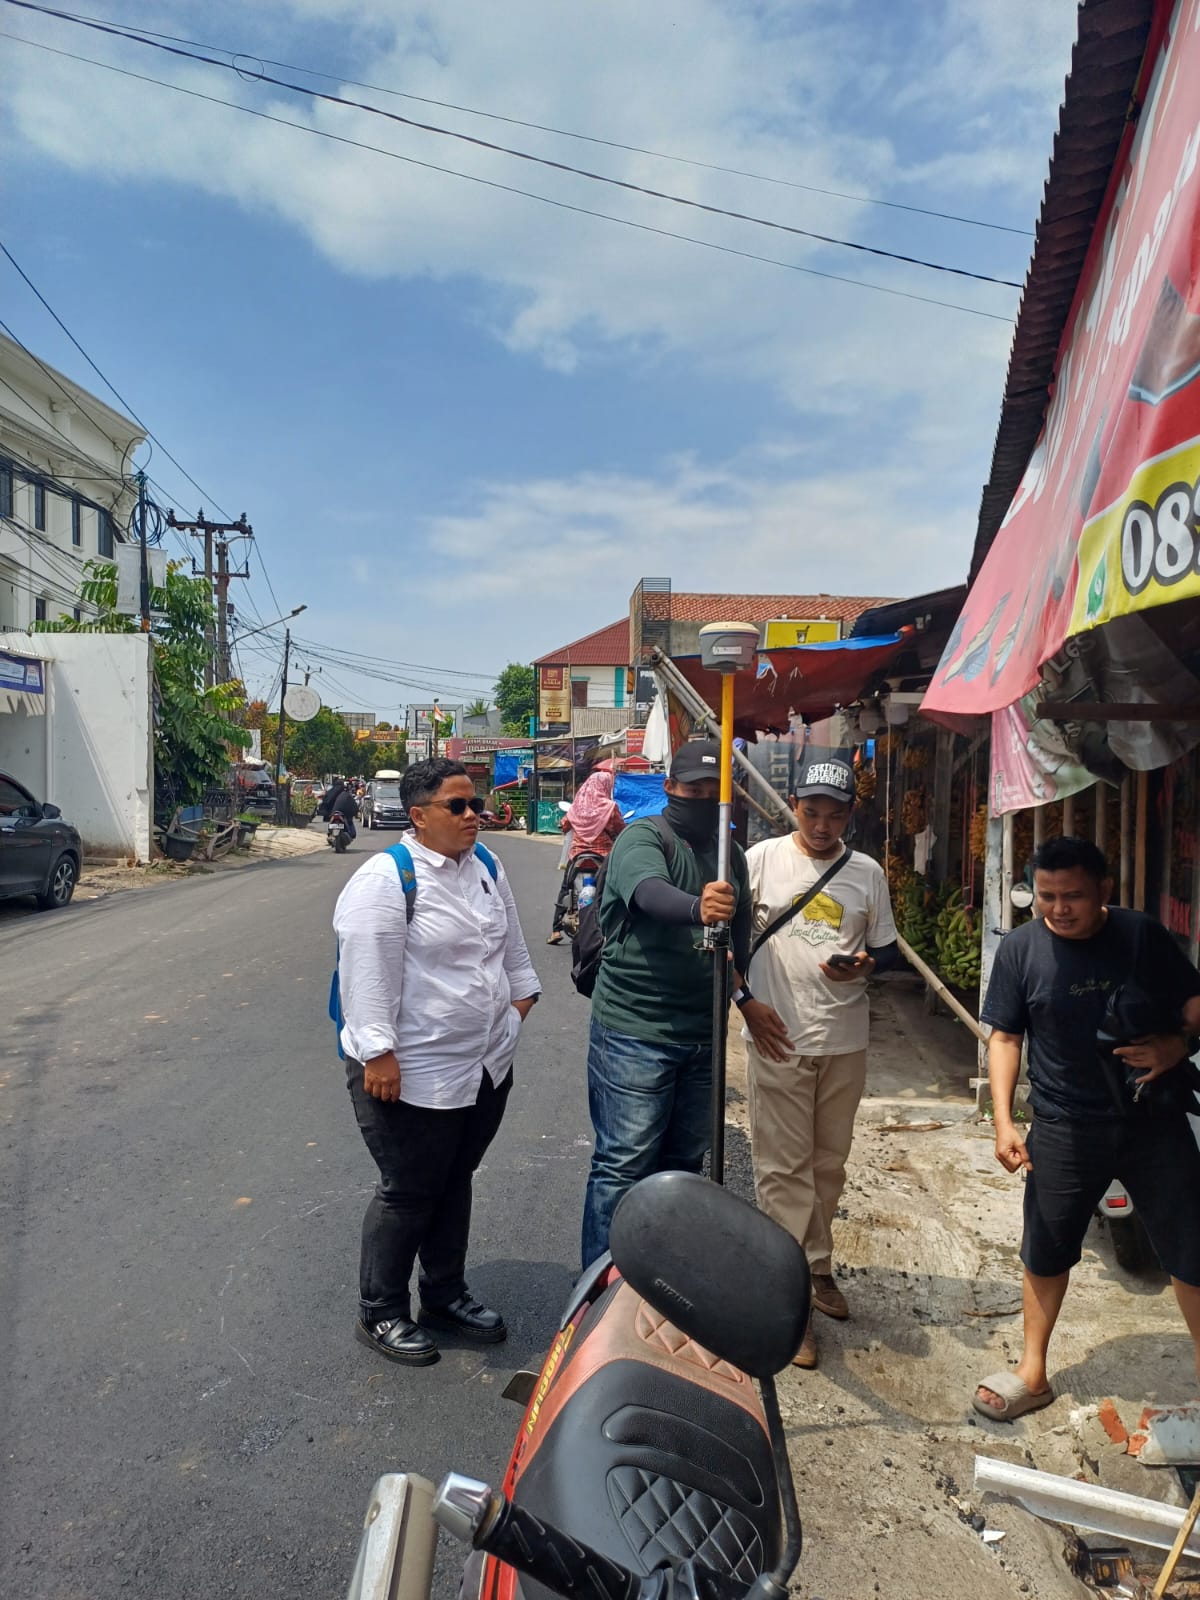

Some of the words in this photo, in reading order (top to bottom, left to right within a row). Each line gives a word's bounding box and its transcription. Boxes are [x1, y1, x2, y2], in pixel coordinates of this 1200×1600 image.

[1121, 481, 1200, 596] 08
[807, 769, 848, 784] GATEBALL
[808, 763, 849, 777] CERTIFIED
[805, 776, 842, 787] REFEREE
[788, 924, 811, 938] Local
[655, 1278, 696, 1312] SUZUKI
